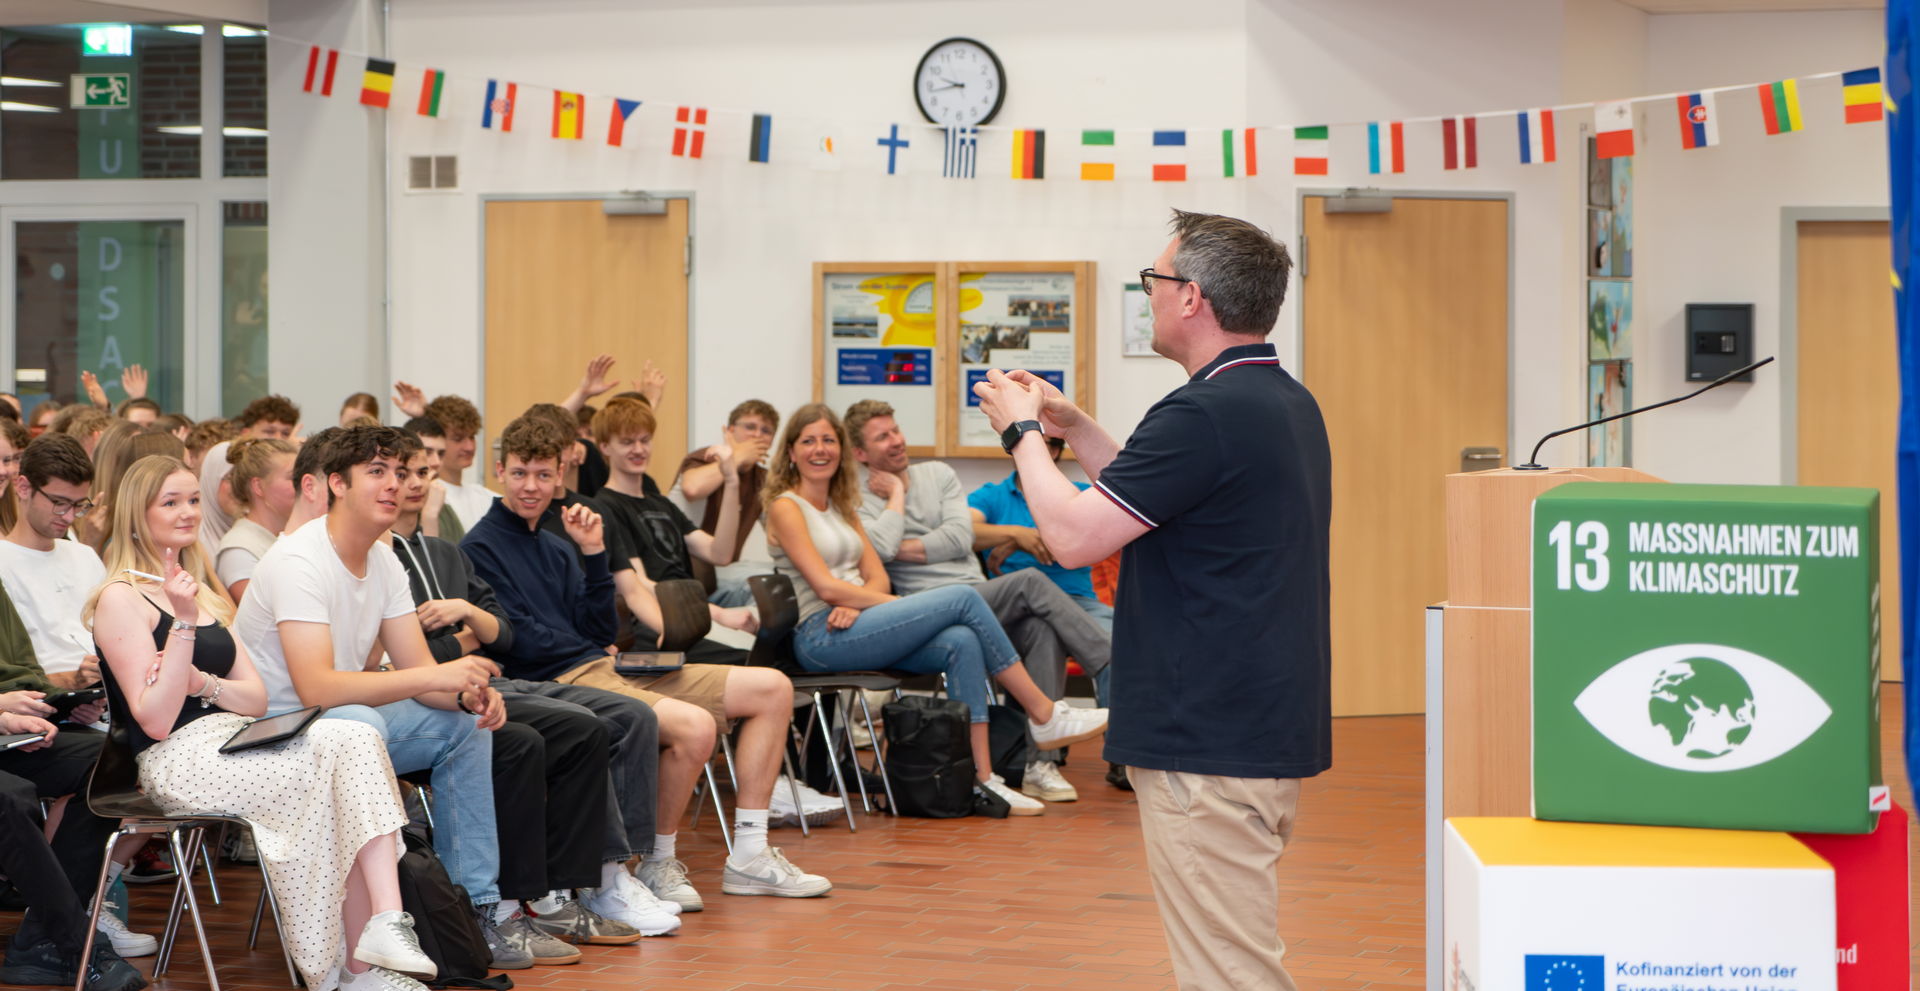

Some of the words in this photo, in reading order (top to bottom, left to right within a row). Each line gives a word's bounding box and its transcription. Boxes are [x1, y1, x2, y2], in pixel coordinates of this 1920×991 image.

[954, 48, 966, 59] 12
[1629, 522, 1801, 556] MASSNAHMEN
[1805, 526, 1859, 558] ZUM
[1549, 520, 1610, 591] 13
[1629, 561, 1799, 596] KLIMASCHUTZ
[1836, 943, 1857, 964] nd
[1616, 961, 1724, 977] Kofinanziert
[1729, 966, 1762, 977] von
[1769, 964, 1798, 977] der
